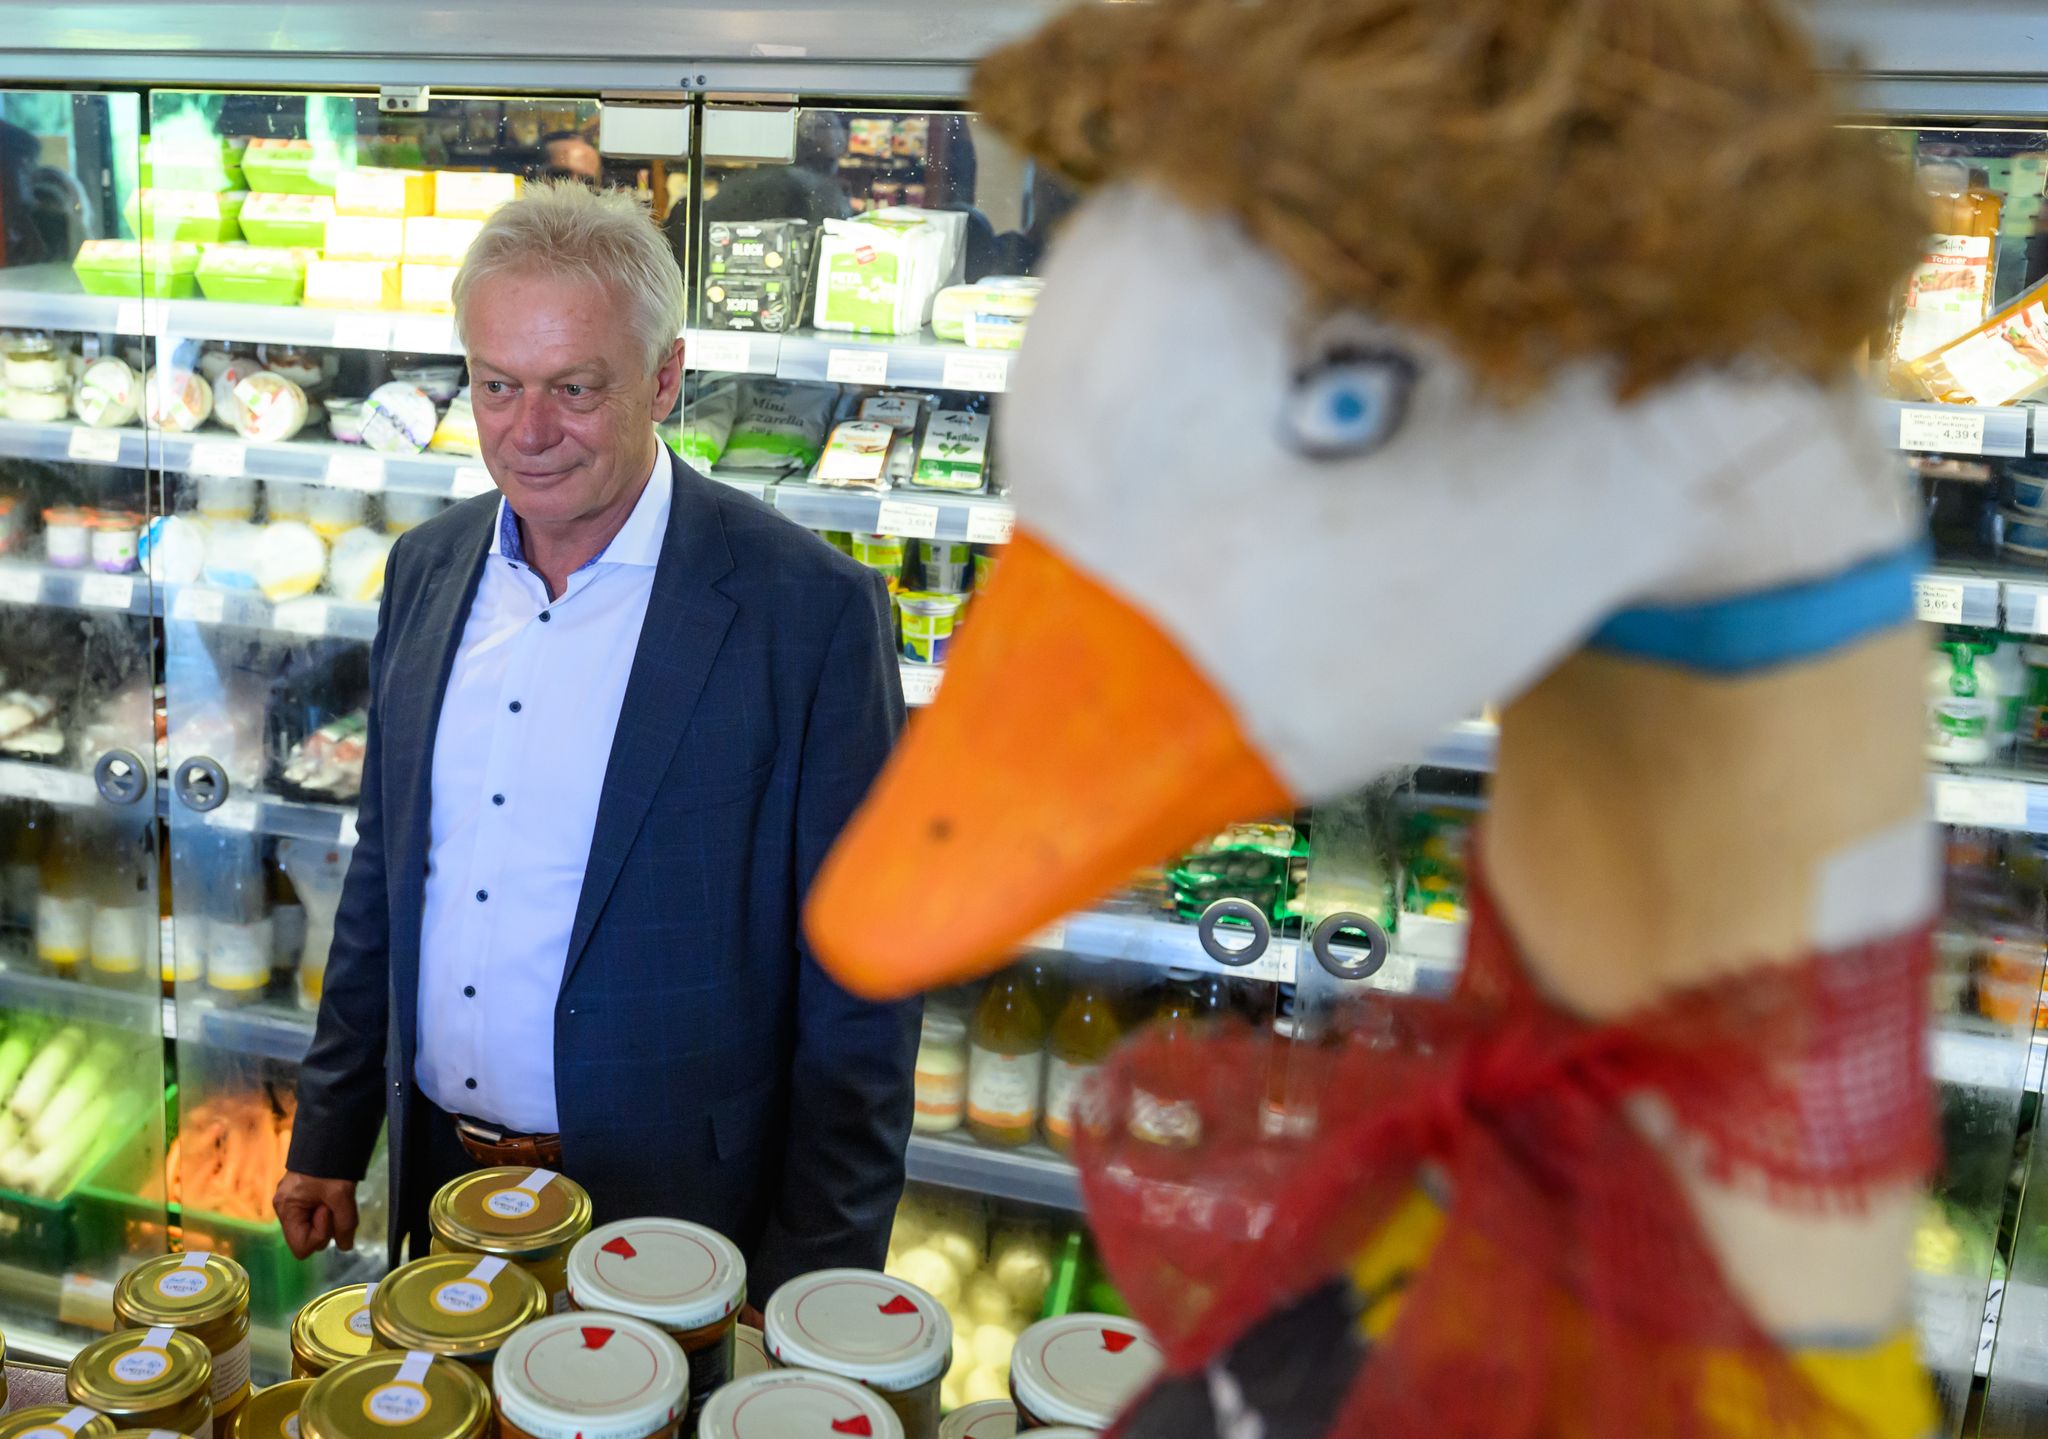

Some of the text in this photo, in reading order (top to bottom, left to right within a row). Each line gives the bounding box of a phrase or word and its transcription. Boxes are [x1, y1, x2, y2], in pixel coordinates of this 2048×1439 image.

[732, 243, 764, 256] BLOCK
[752, 397, 785, 412] Mini
[1943, 429, 1980, 440] 4,39 €
[1952, 600, 1960, 610] €
